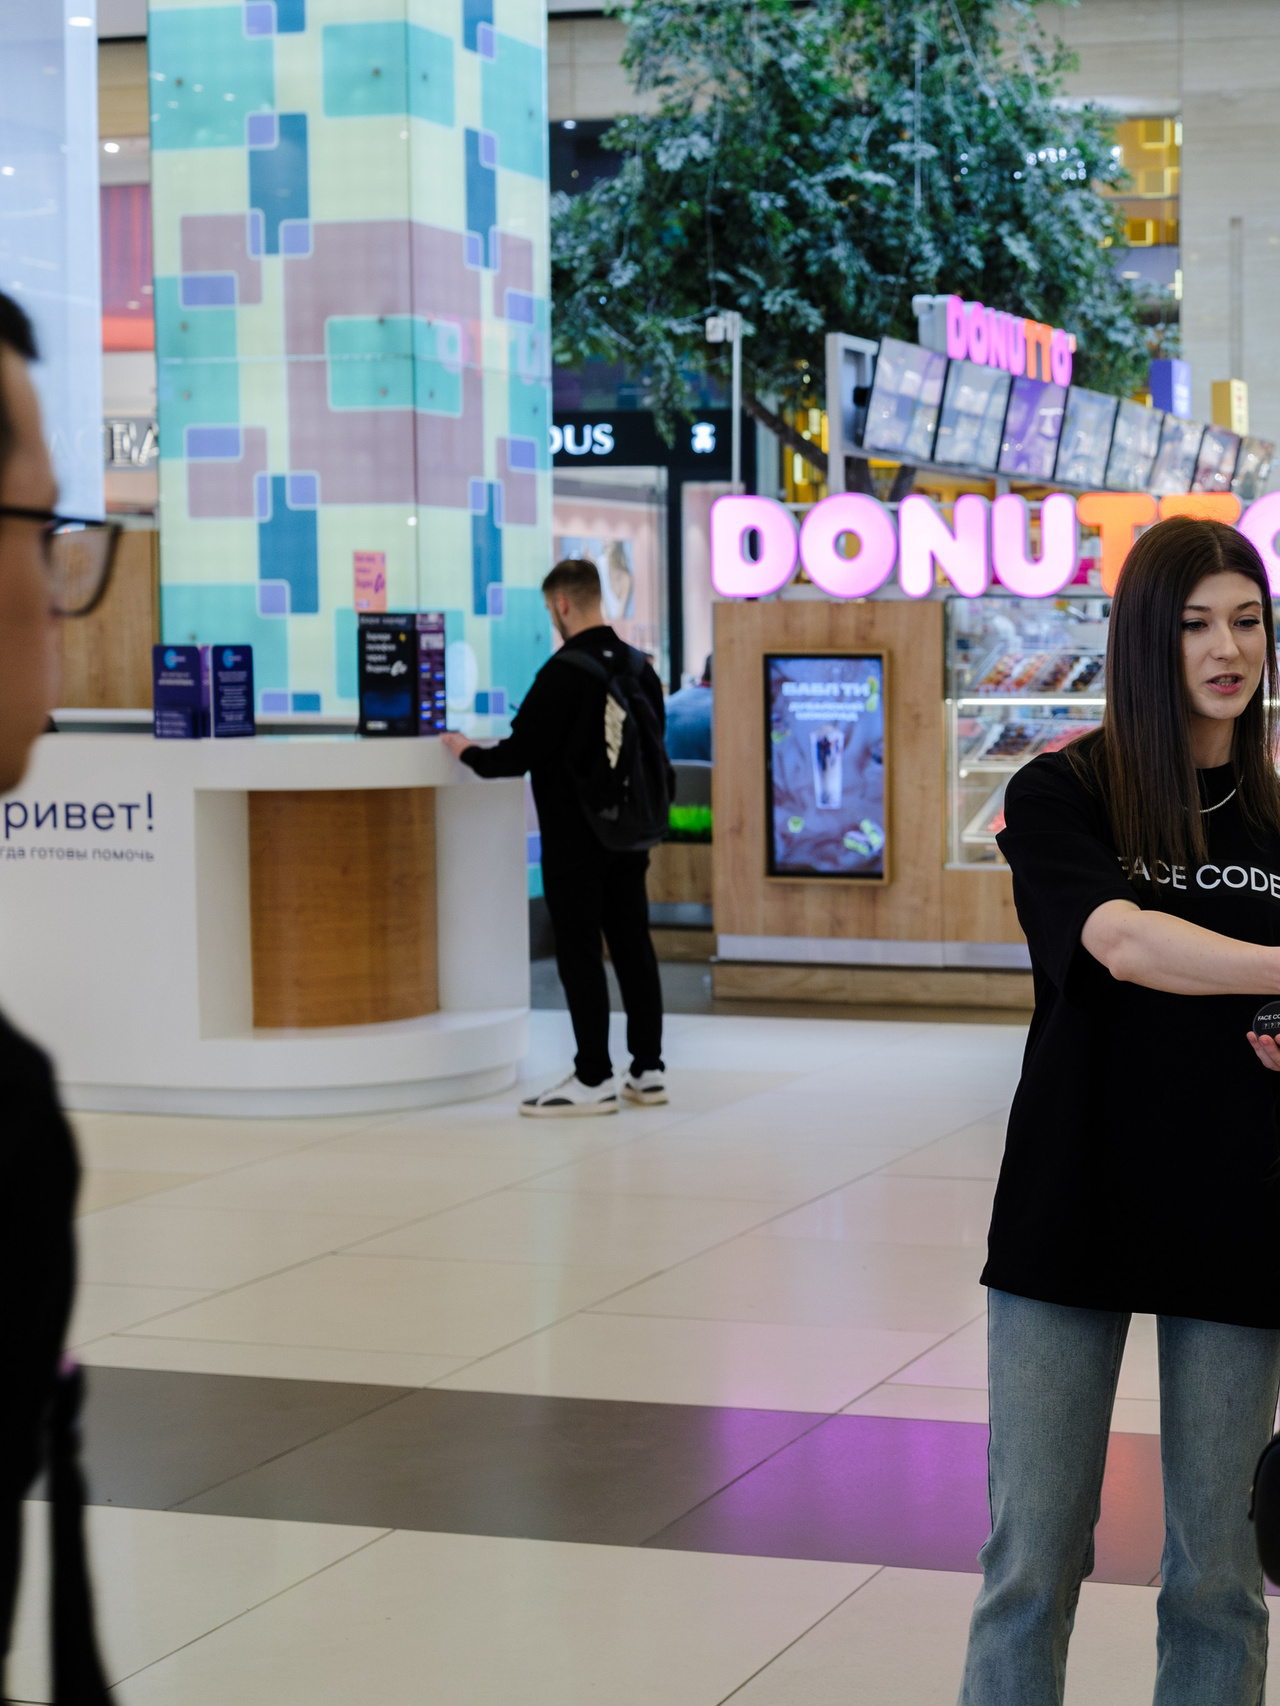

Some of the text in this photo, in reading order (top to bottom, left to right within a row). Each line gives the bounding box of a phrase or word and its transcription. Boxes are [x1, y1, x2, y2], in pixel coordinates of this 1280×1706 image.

[946, 294, 1074, 388] DONUTTO
[4, 790, 154, 840] ривет!
[30, 846, 88, 861] готовы
[92, 847, 155, 862] помочь
